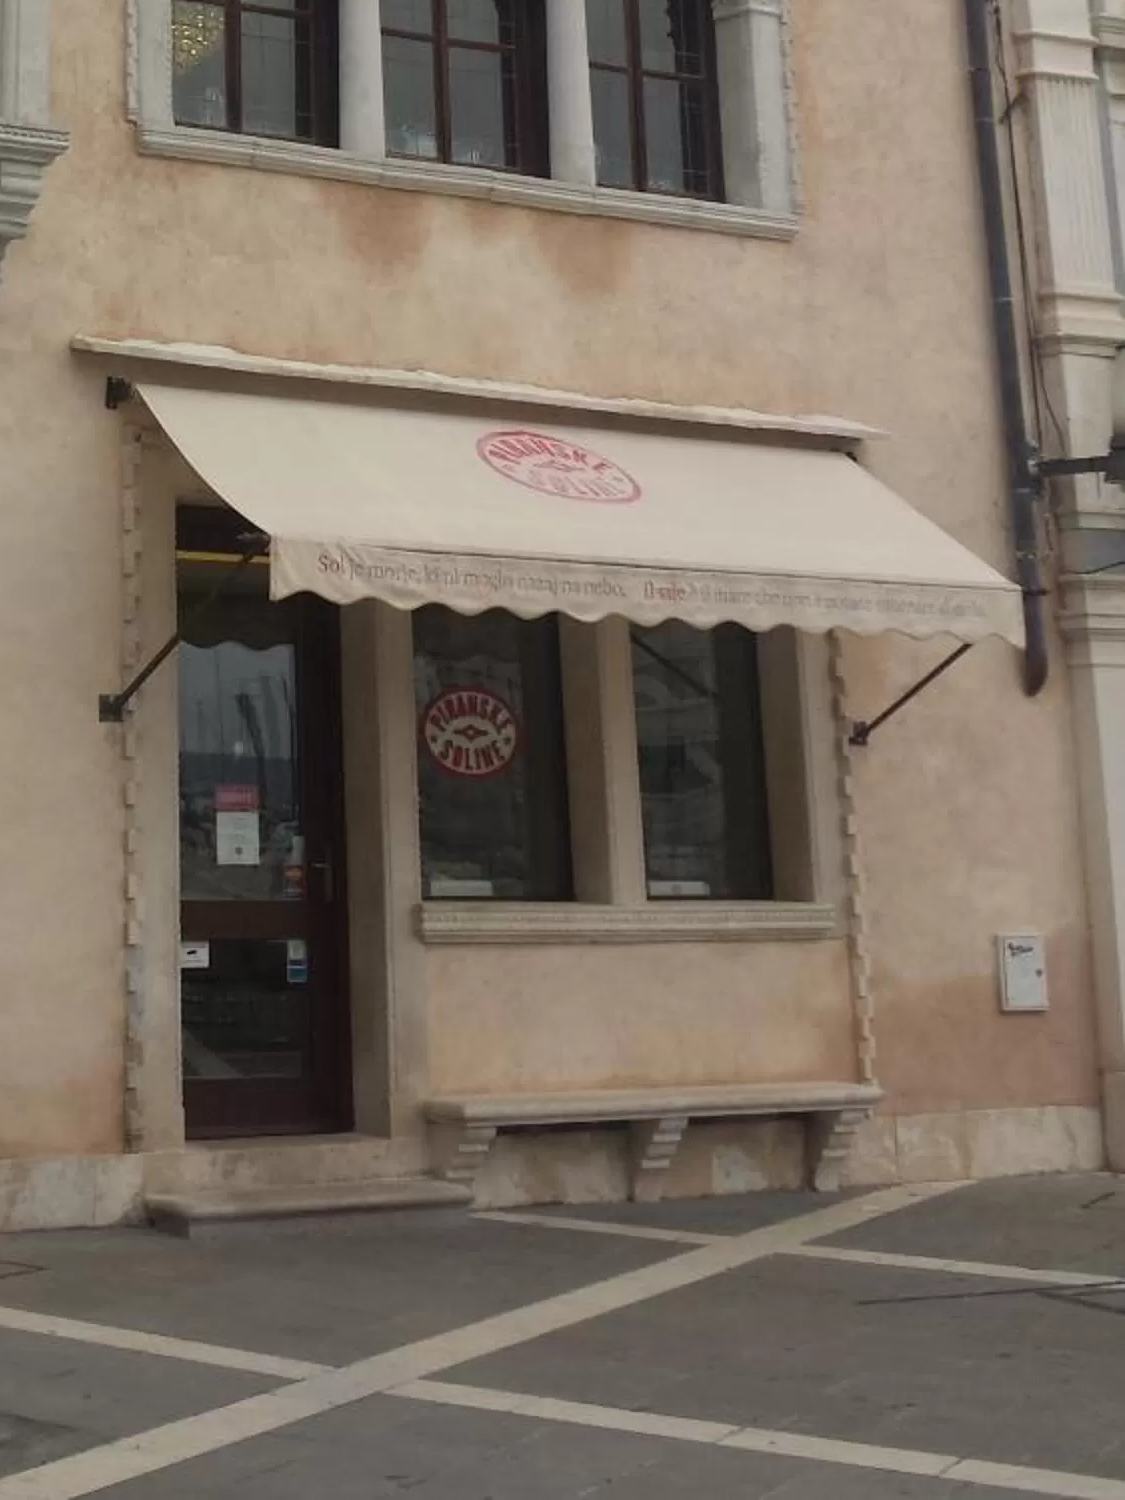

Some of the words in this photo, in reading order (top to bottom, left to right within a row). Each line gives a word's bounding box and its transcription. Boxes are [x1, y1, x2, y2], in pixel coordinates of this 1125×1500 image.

[317, 553, 346, 573] Sol
[430, 693, 512, 736] PIRANSKE
[438, 739, 506, 770] SOLINE
